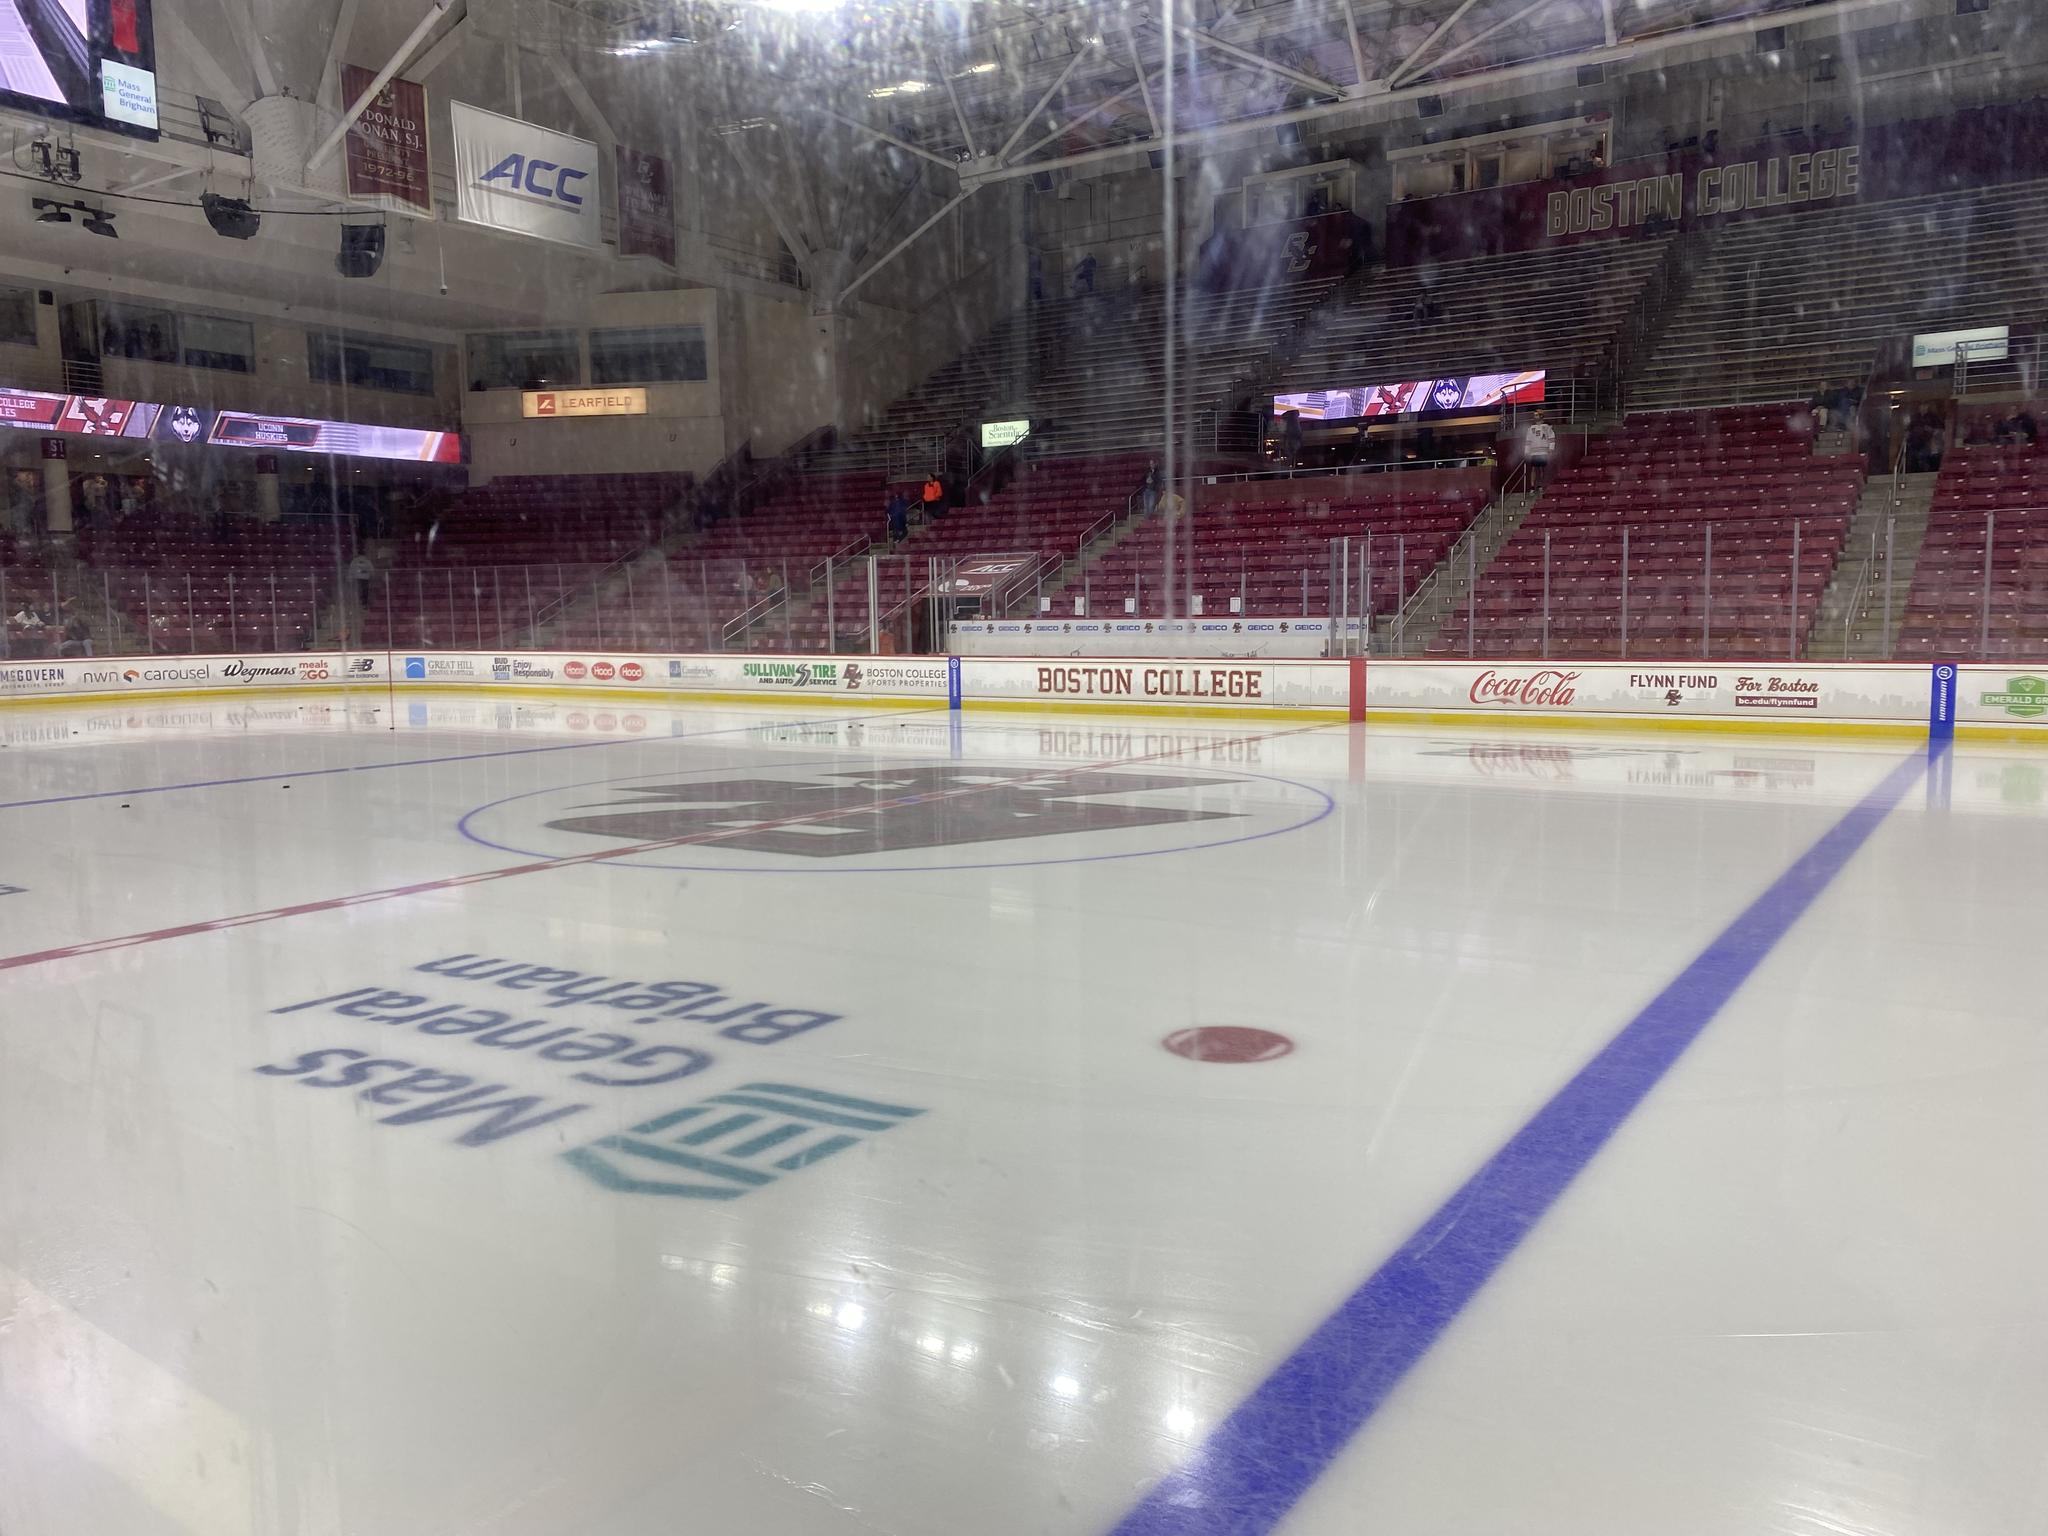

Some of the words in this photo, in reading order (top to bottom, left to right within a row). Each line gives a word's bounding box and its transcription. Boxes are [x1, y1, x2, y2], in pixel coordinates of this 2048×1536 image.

[118, 79, 141, 92] Mass
[118, 88, 152, 104] General
[120, 97, 155, 114] Brigham
[366, 109, 416, 131] DONALD
[358, 121, 401, 144] ONAN,
[480, 153, 588, 205] ACC
[1547, 173, 1683, 236] BOSTON
[1697, 145, 1860, 217] COLLEGE
[561, 396, 632, 408] LEARFIELD
[258, 423, 284, 434] UCONN
[255, 431, 289, 442] HUSKIES
[299, 660, 328, 669] meals
[428, 660, 455, 670] GREAT
[457, 660, 474, 670] HILL
[494, 657, 508, 665] BUD
[513, 660, 531, 671] Enjoy
[83, 671, 119, 683] nwn
[144, 664, 210, 681] carousel
[223, 660, 296, 683] Wegmans
[492, 664, 512, 672] LIGHT
[513, 668, 554, 680] Responsibly
[593, 666, 613, 676] Hood
[621, 667, 642, 677] Hood
[744, 664, 795, 677] SULLIVAN
[812, 664, 836, 678] TIRE
[867, 668, 903, 678] BOSTON
[905, 669, 947, 679] COLLEGE
[300, 669, 329, 680] 2GO
[809, 678, 837, 686] SERVICE
[899, 680, 948, 688] PROPERTIES
[1038, 668, 1133, 694] BOSTON
[1144, 669, 1262, 698] COLLEGE
[1630, 674, 1675, 688] FLYNN
[1679, 675, 1717, 689] FUND
[1735, 676, 1763, 692] For
[1767, 677, 1819, 693] Boston
[1469, 670, 1583, 706] Coca-Cola
[1738, 697, 1815, 707] bc.edu/flynnfund
[1984, 695, 2032, 704] EMERALD
[414, 953, 844, 1045] Brigham
[268, 986, 714, 1087] General
[253, 1048, 594, 1148] Mass
